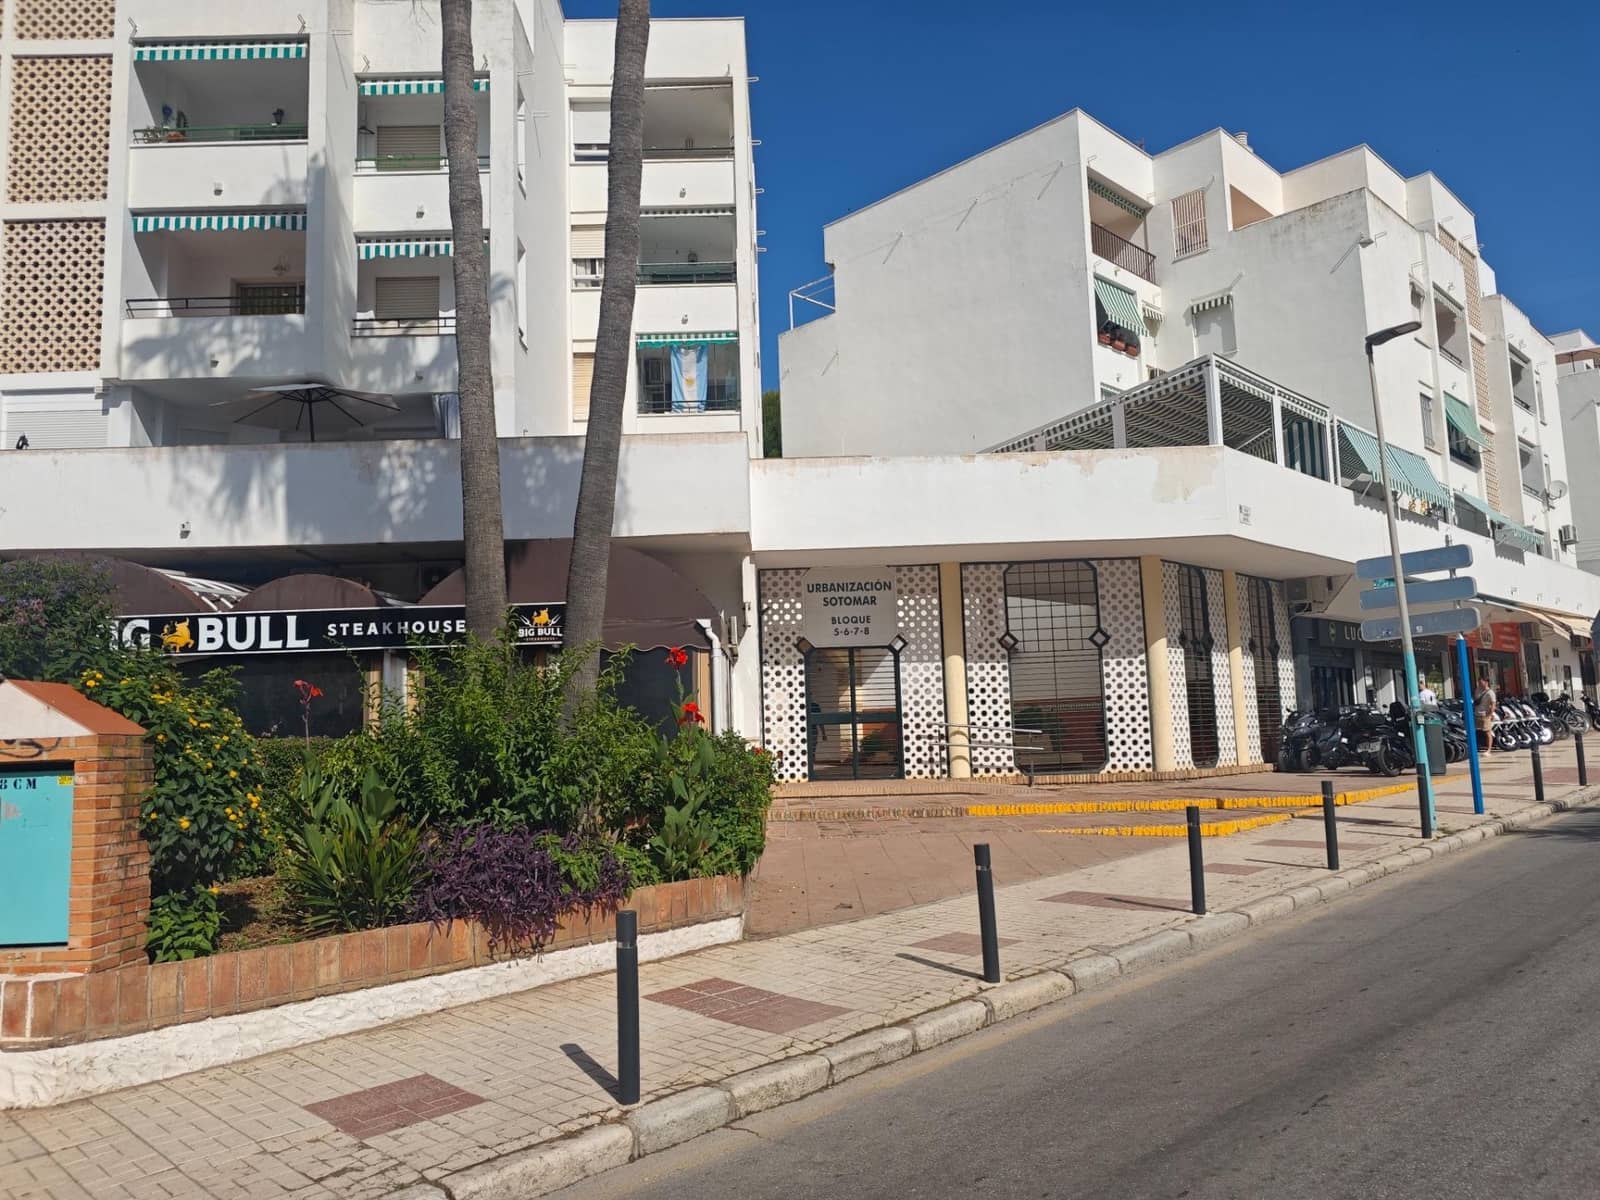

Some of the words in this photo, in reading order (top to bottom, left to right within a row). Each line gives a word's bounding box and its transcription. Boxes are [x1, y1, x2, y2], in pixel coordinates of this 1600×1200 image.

[806, 579, 892, 593] URBANIZACIÓN
[823, 596, 877, 607] SOTOMAR
[831, 615, 872, 625] BLOQUE
[197, 615, 310, 651] BULL
[327, 619, 467, 637] STEAKHOUSE
[518, 628, 535, 637] BIG
[537, 627, 563, 637] BULL
